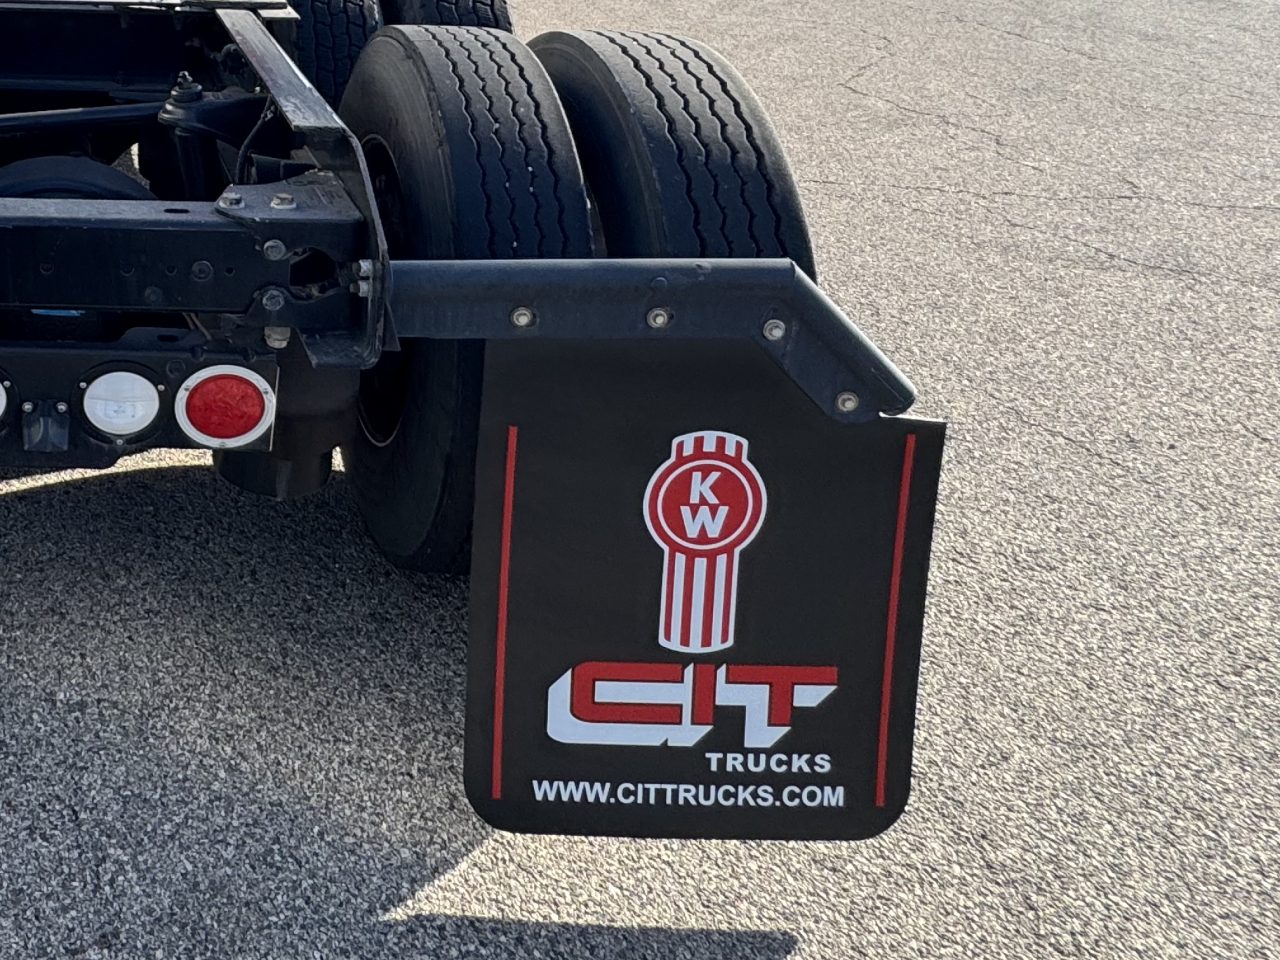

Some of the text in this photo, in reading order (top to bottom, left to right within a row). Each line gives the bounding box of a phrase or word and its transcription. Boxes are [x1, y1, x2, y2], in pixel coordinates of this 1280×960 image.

[547, 661, 838, 748] CIT
[704, 752, 832, 773] TRUCKS
[532, 780, 845, 807] WWW.CITTRUCKS.COM
